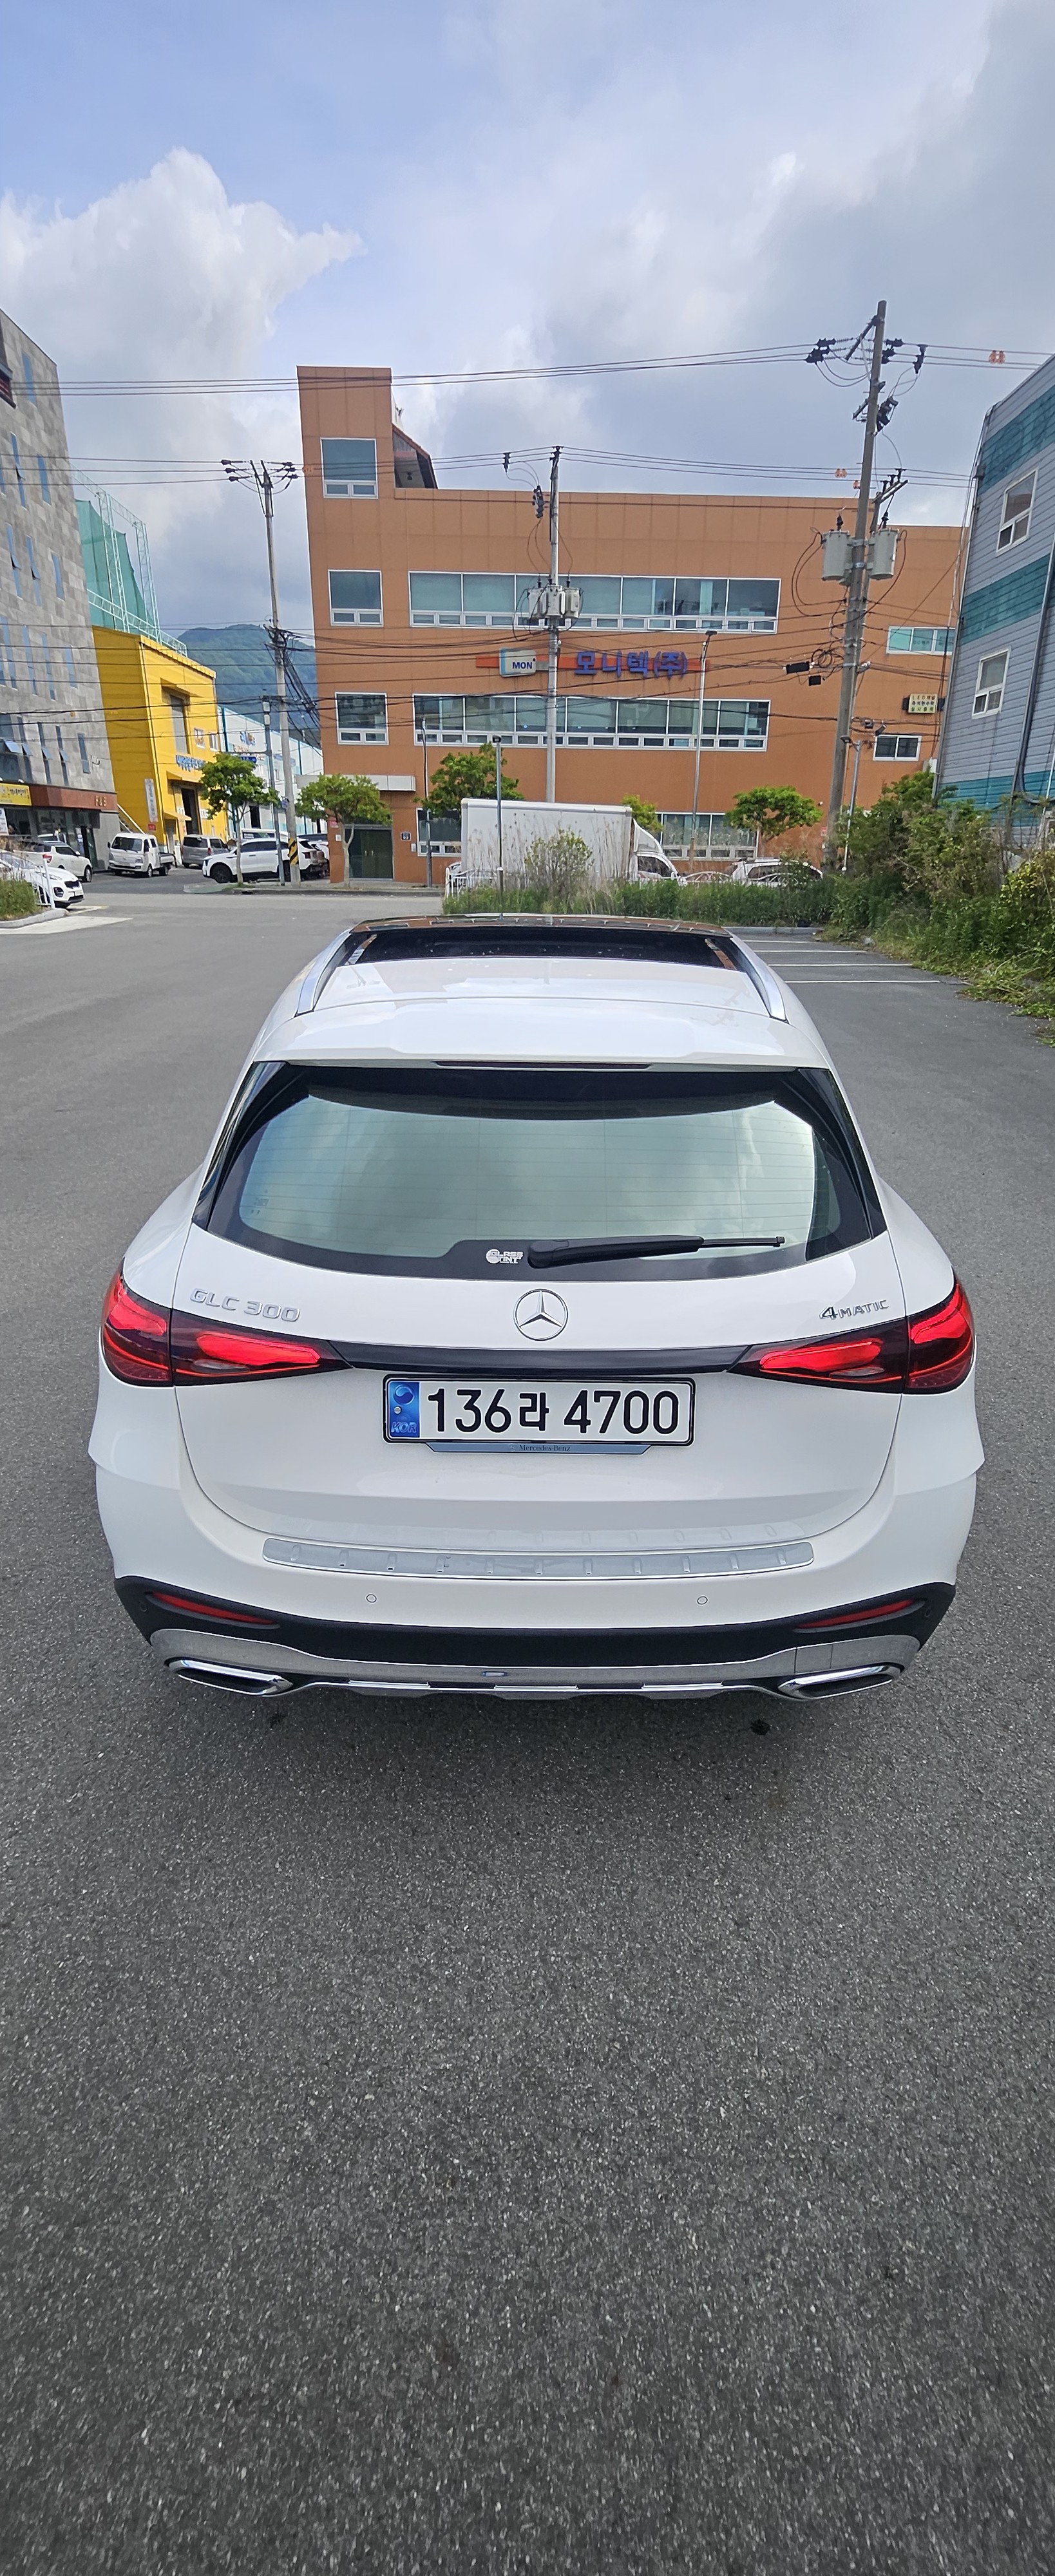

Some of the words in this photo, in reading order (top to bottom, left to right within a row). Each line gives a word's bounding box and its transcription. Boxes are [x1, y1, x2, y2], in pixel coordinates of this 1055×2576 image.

[512, 661, 533, 670] MON
[575, 650, 688, 678] 모니텍(주)
[190, 1288, 240, 1311] GLC
[243, 1300, 300, 1322] 300
[819, 1300, 889, 1320] 4MATIC
[428, 1388, 549, 1433] 136라
[564, 1389, 680, 1435] 4700
[391, 1421, 417, 1434] KOR
